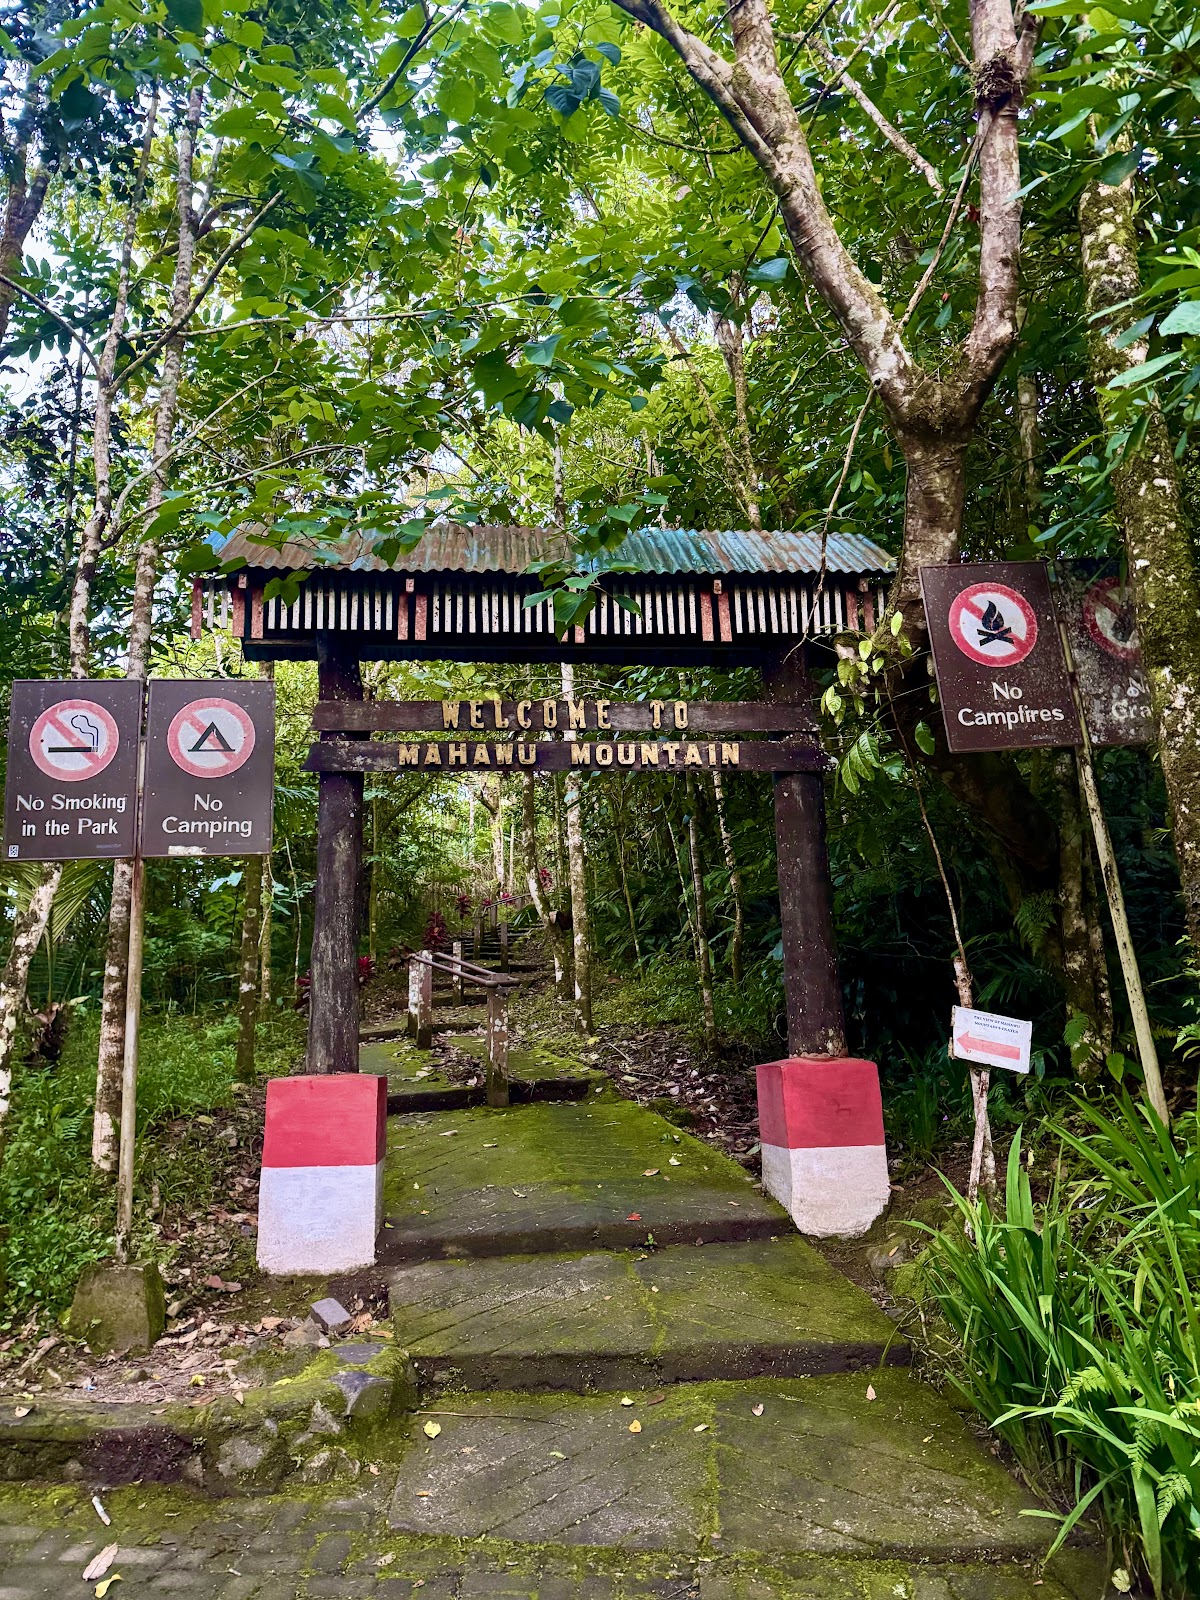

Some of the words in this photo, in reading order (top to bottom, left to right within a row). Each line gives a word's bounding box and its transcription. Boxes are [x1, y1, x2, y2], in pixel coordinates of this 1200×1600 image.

[991, 682, 1023, 701] No
[441, 699, 612, 729] WELCOME
[649, 699, 689, 730] TO
[957, 704, 1065, 730] Campfires
[1112, 698, 1152, 719] Gra
[398, 742, 537, 765] MAHAWU
[571, 743, 740, 766] MOUNTAIN
[16, 794, 45, 811] No
[51, 793, 127, 813] Smoking
[194, 793, 223, 811] No
[22, 819, 36, 836] in
[45, 818, 70, 836] the
[78, 818, 119, 835] Park
[162, 815, 253, 838] Camping
